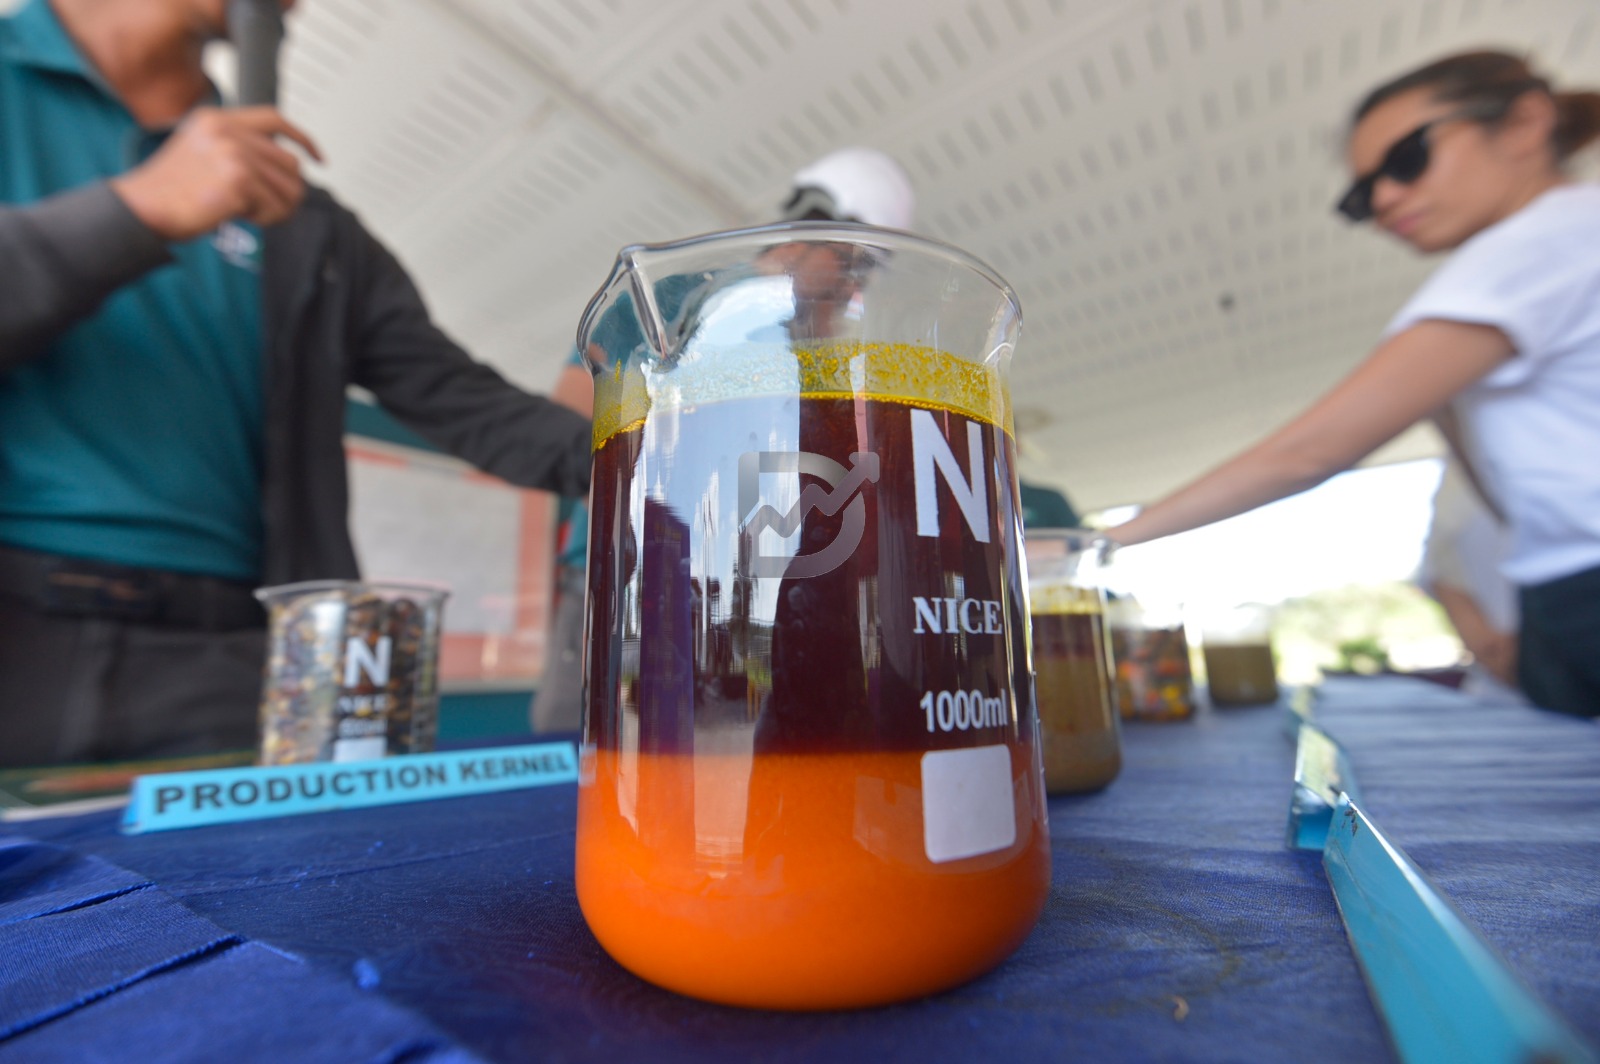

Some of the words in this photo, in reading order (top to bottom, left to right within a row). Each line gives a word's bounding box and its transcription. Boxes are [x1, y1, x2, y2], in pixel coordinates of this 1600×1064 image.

[910, 408, 990, 543] N
[913, 598, 1002, 634] NICE
[344, 636, 392, 687] N
[920, 690, 1008, 732] 1000ml
[154, 762, 446, 815] PRODUCTION
[459, 752, 571, 783] KERNEL
